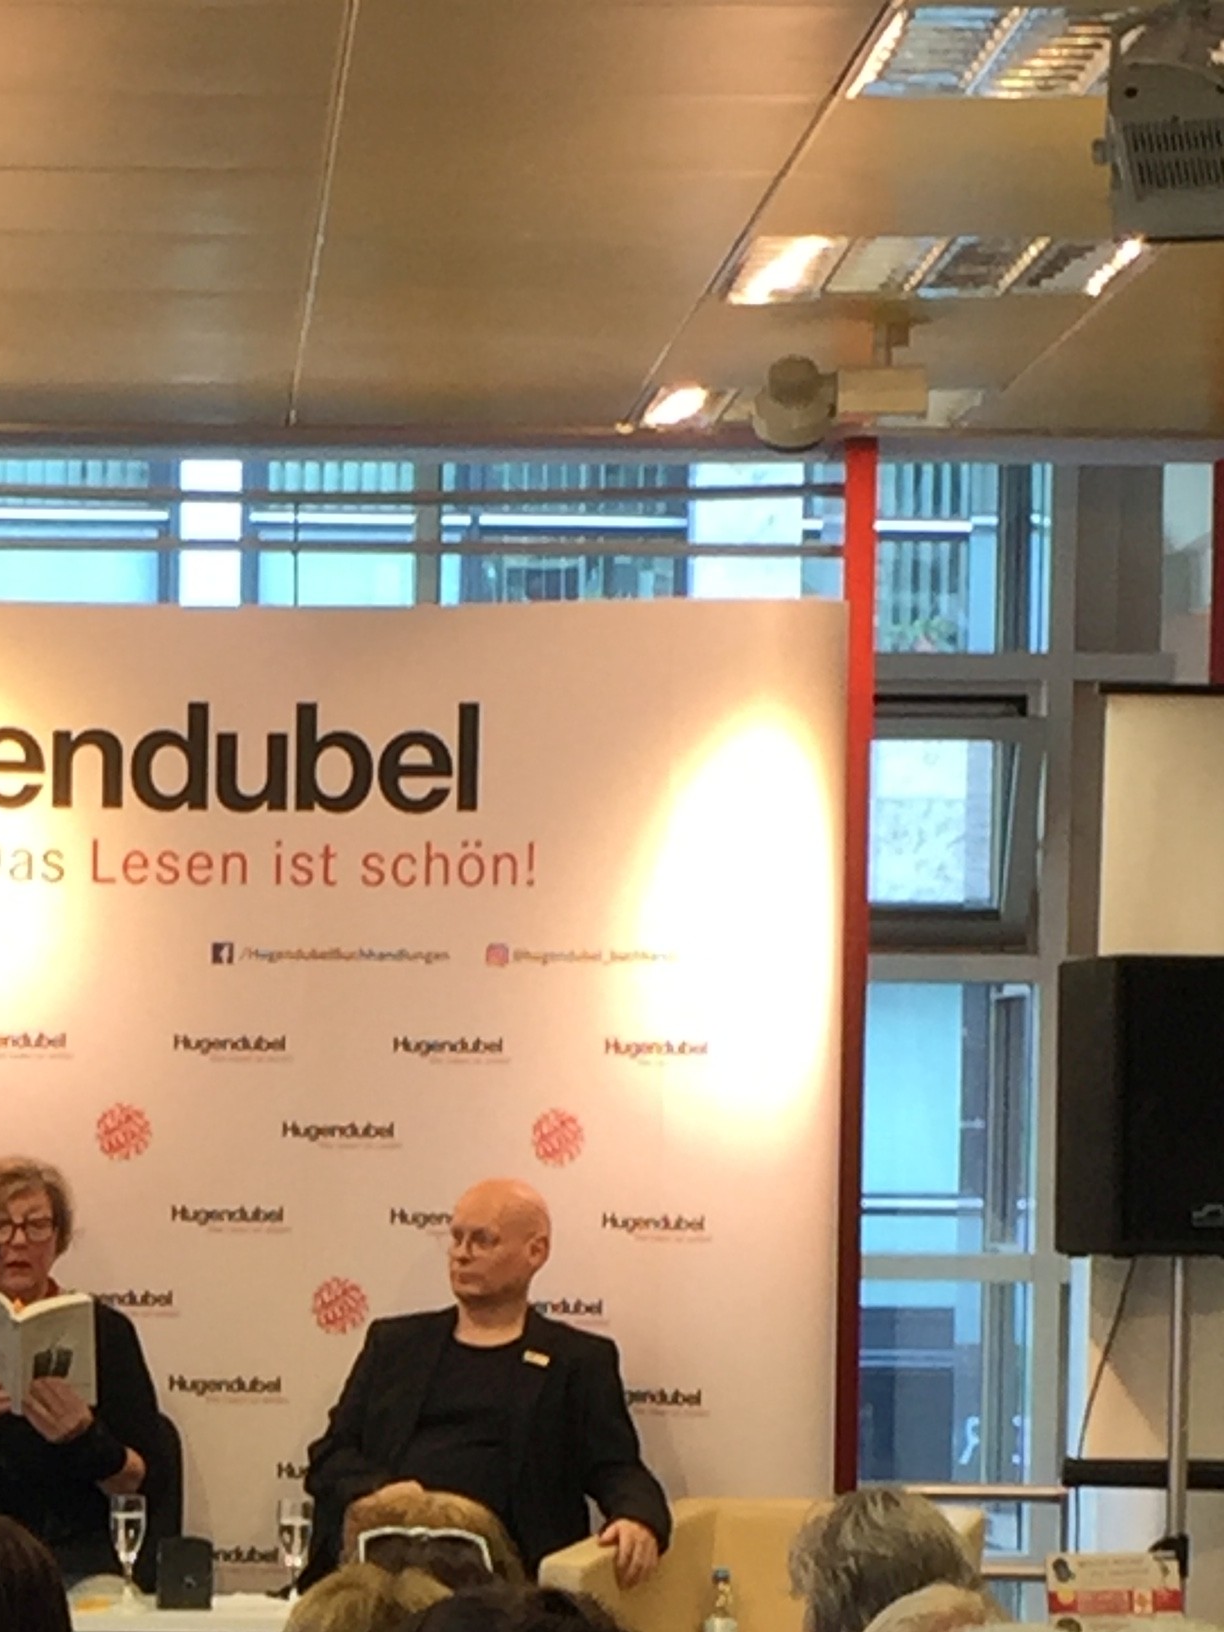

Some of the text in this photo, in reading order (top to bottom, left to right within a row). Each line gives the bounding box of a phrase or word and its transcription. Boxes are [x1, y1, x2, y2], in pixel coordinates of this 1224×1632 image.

[91, 838, 249, 887] Lesen
[274, 840, 338, 888] ist
[360, 840, 536, 888] schön!
[173, 1034, 287, 1055] Hugendubel
[392, 1037, 504, 1058] Hugendubel
[604, 1037, 708, 1060] Hugendubel
[282, 1121, 395, 1143] Hugendubel
[171, 1204, 284, 1226] Hugendubel
[390, 1207, 453, 1230] Hugen
[601, 1212, 706, 1234] Hugendubel
[168, 1374, 282, 1397] Hugendubel
